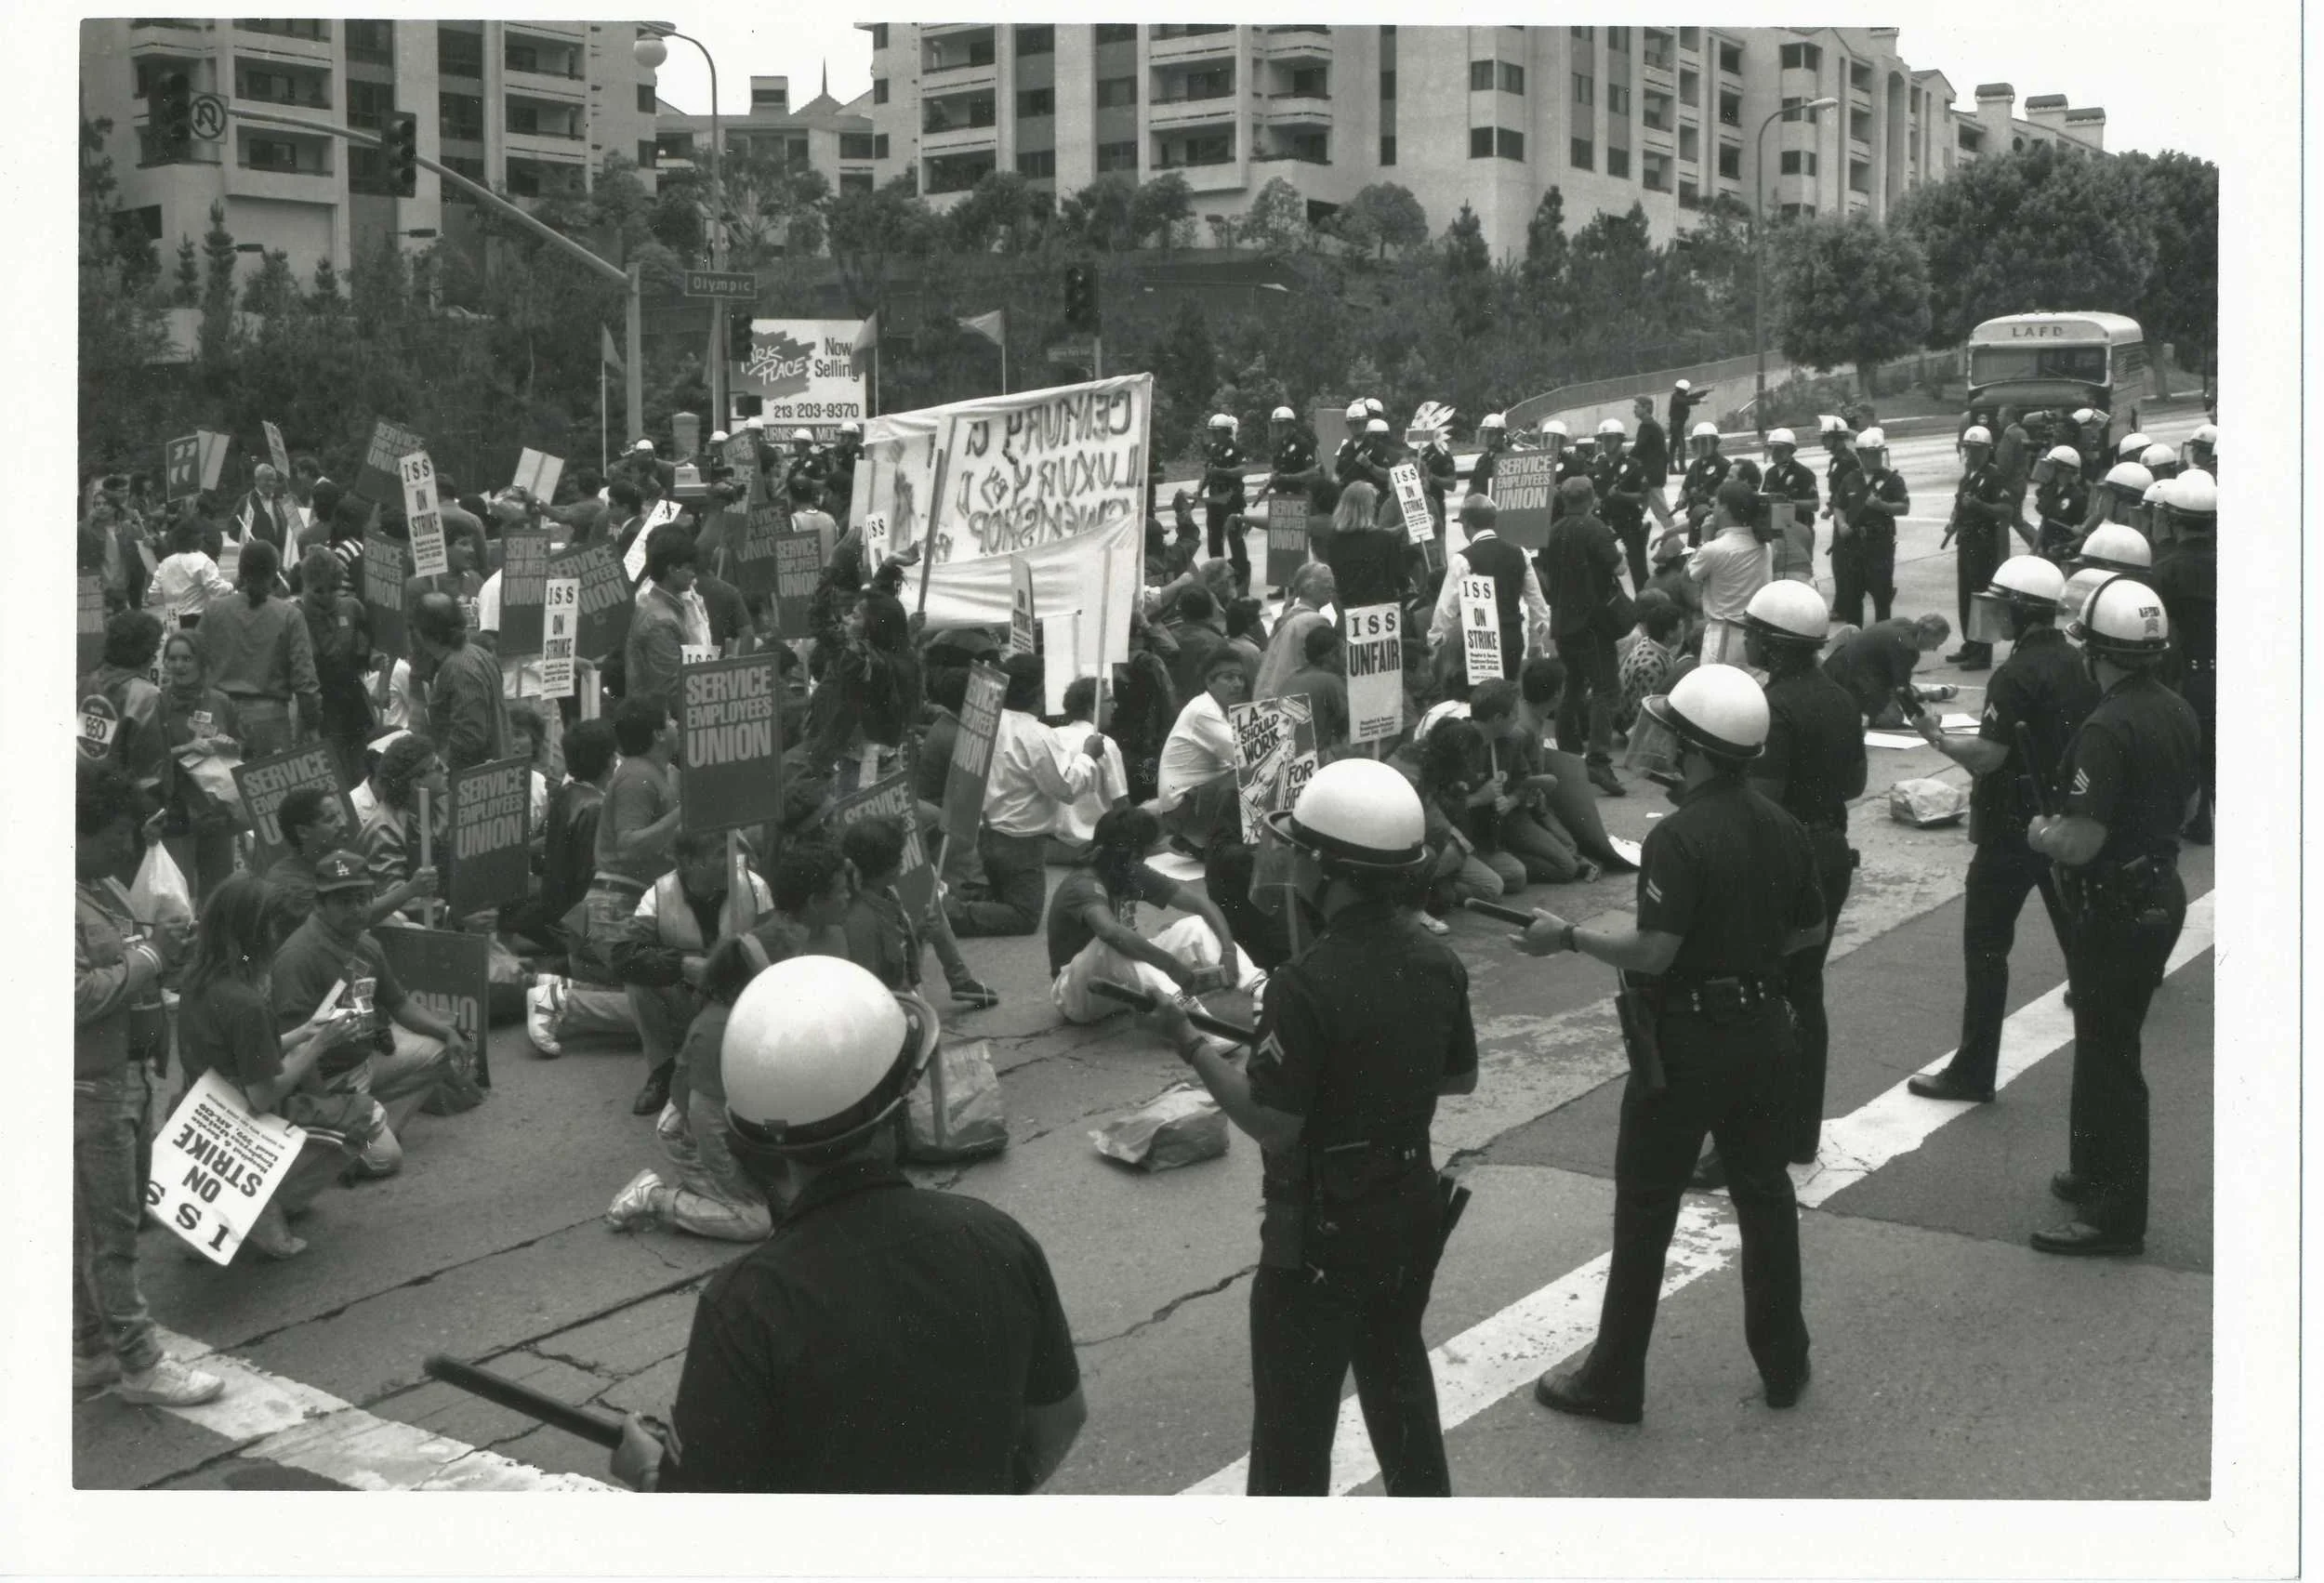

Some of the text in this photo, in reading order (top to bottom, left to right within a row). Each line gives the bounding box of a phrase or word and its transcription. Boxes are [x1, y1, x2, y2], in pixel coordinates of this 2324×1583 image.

[693, 277, 750, 292] Olympic
[2012, 326, 2064, 337] LAFD
[825, 336, 853, 357] Now
[747, 357, 806, 386] PLACE
[814, 359, 860, 382] Selling
[774, 402, 859, 418] 213 203-9370
[404, 459, 430, 482] ISS
[1394, 468, 1417, 483] ISS
[1498, 455, 1552, 475] SERVICE
[1496, 473, 1551, 490] EMPLOYEES
[1494, 487, 1548, 511] UNION
[548, 587, 574, 605] ISS
[1463, 581, 1492, 600] ISS
[1351, 612, 1396, 638] ISS
[1473, 607, 1487, 627] ON
[1467, 629, 1499, 650] STRIKE
[1349, 638, 1400, 678] UNFAIR
[685, 665, 772, 706] SERVICE
[687, 694, 773, 730] EMPLOYEES
[1240, 713, 1280, 745] SHOULD
[687, 719, 772, 769] UNION
[1242, 727, 1281, 765] WORK
[242, 749, 333, 798] SERVICE
[1287, 759, 1314, 787] FOR
[456, 765, 525, 808] SERVICE
[456, 793, 524, 827] EMPLOYEES
[456, 811, 522, 860] UNION
[172, 1123, 263, 1197] STRIKE
[181, 1165, 222, 1204] ON
